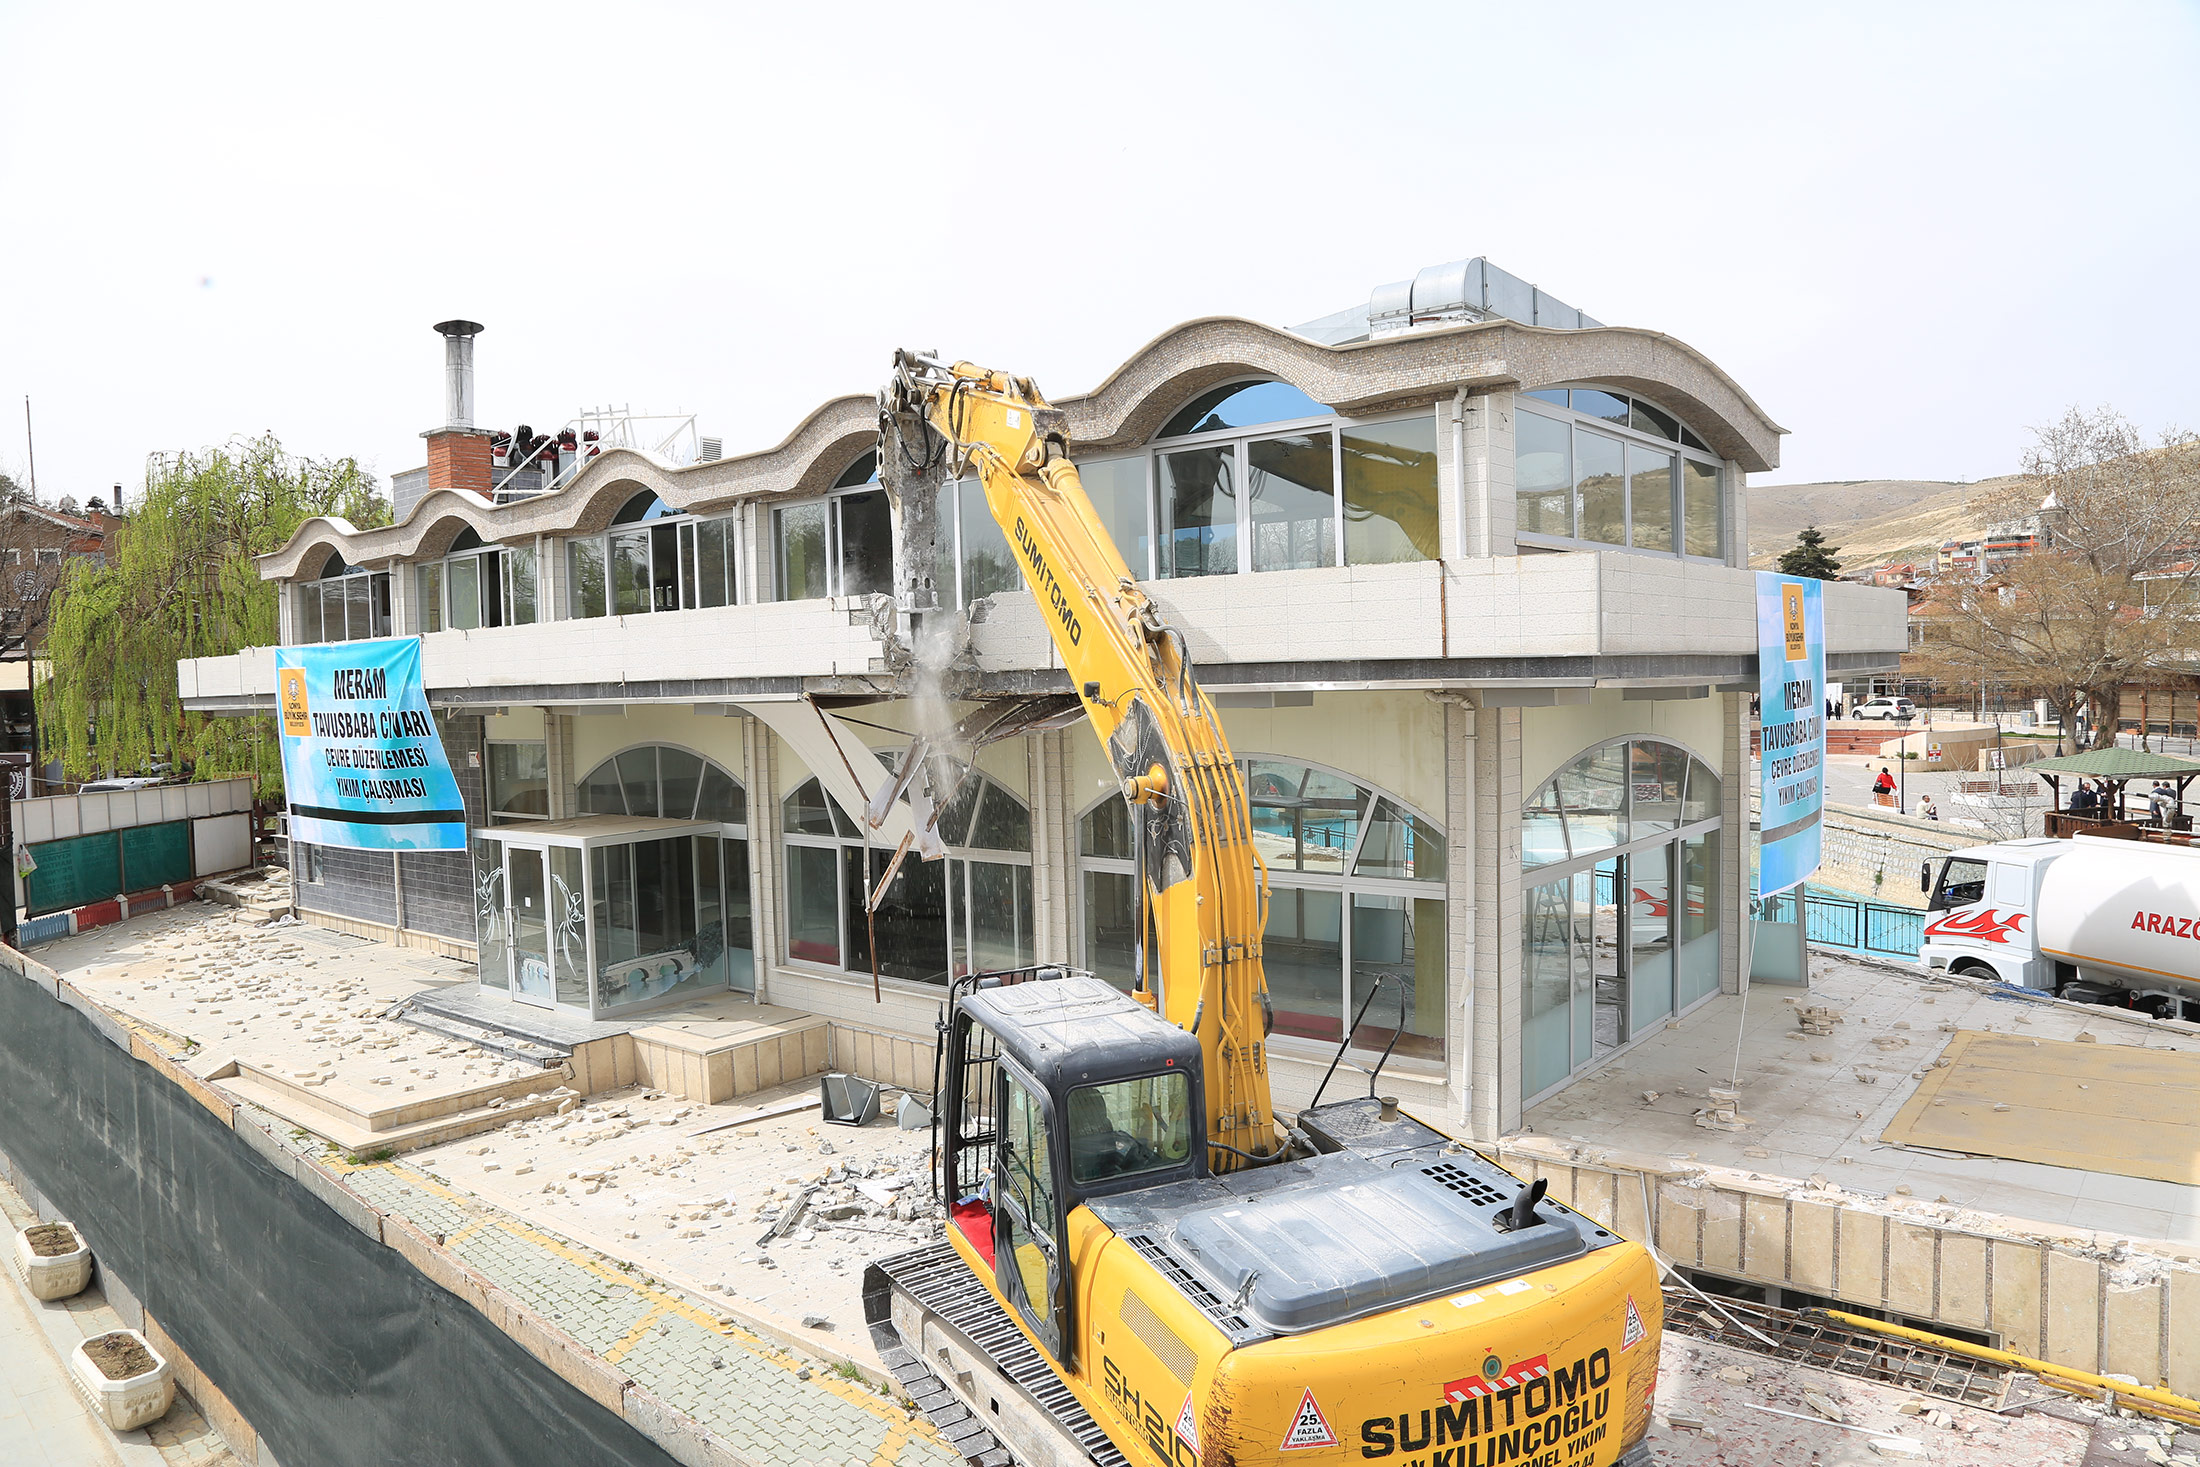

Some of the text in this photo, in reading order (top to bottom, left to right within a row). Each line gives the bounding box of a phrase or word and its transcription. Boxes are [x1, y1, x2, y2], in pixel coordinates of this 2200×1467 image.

[1014, 516, 1082, 647] SUMITOMO
[333, 667, 387, 700] MERAM
[1783, 679, 1813, 711] MERAM
[313, 705, 432, 739] TAVUSBABA CİVARI
[1762, 719, 1808, 752] TAVUSBABA
[325, 742, 430, 772] ÇEVRE DÜZENLEMESİ
[1771, 757, 1792, 785] ÇEVRE
[335, 777, 428, 805] YIKIM ÇALIŞMASI
[1105, 1383, 1151, 1446] SUMITOMO
[1361, 1347, 1611, 1460] SUMITOMO
[1297, 1427, 1323, 1436] FAZLA
[1432, 1387, 1611, 1467] KILINÇOĞLU
[1567, 1422, 1607, 1458] YIKIM
